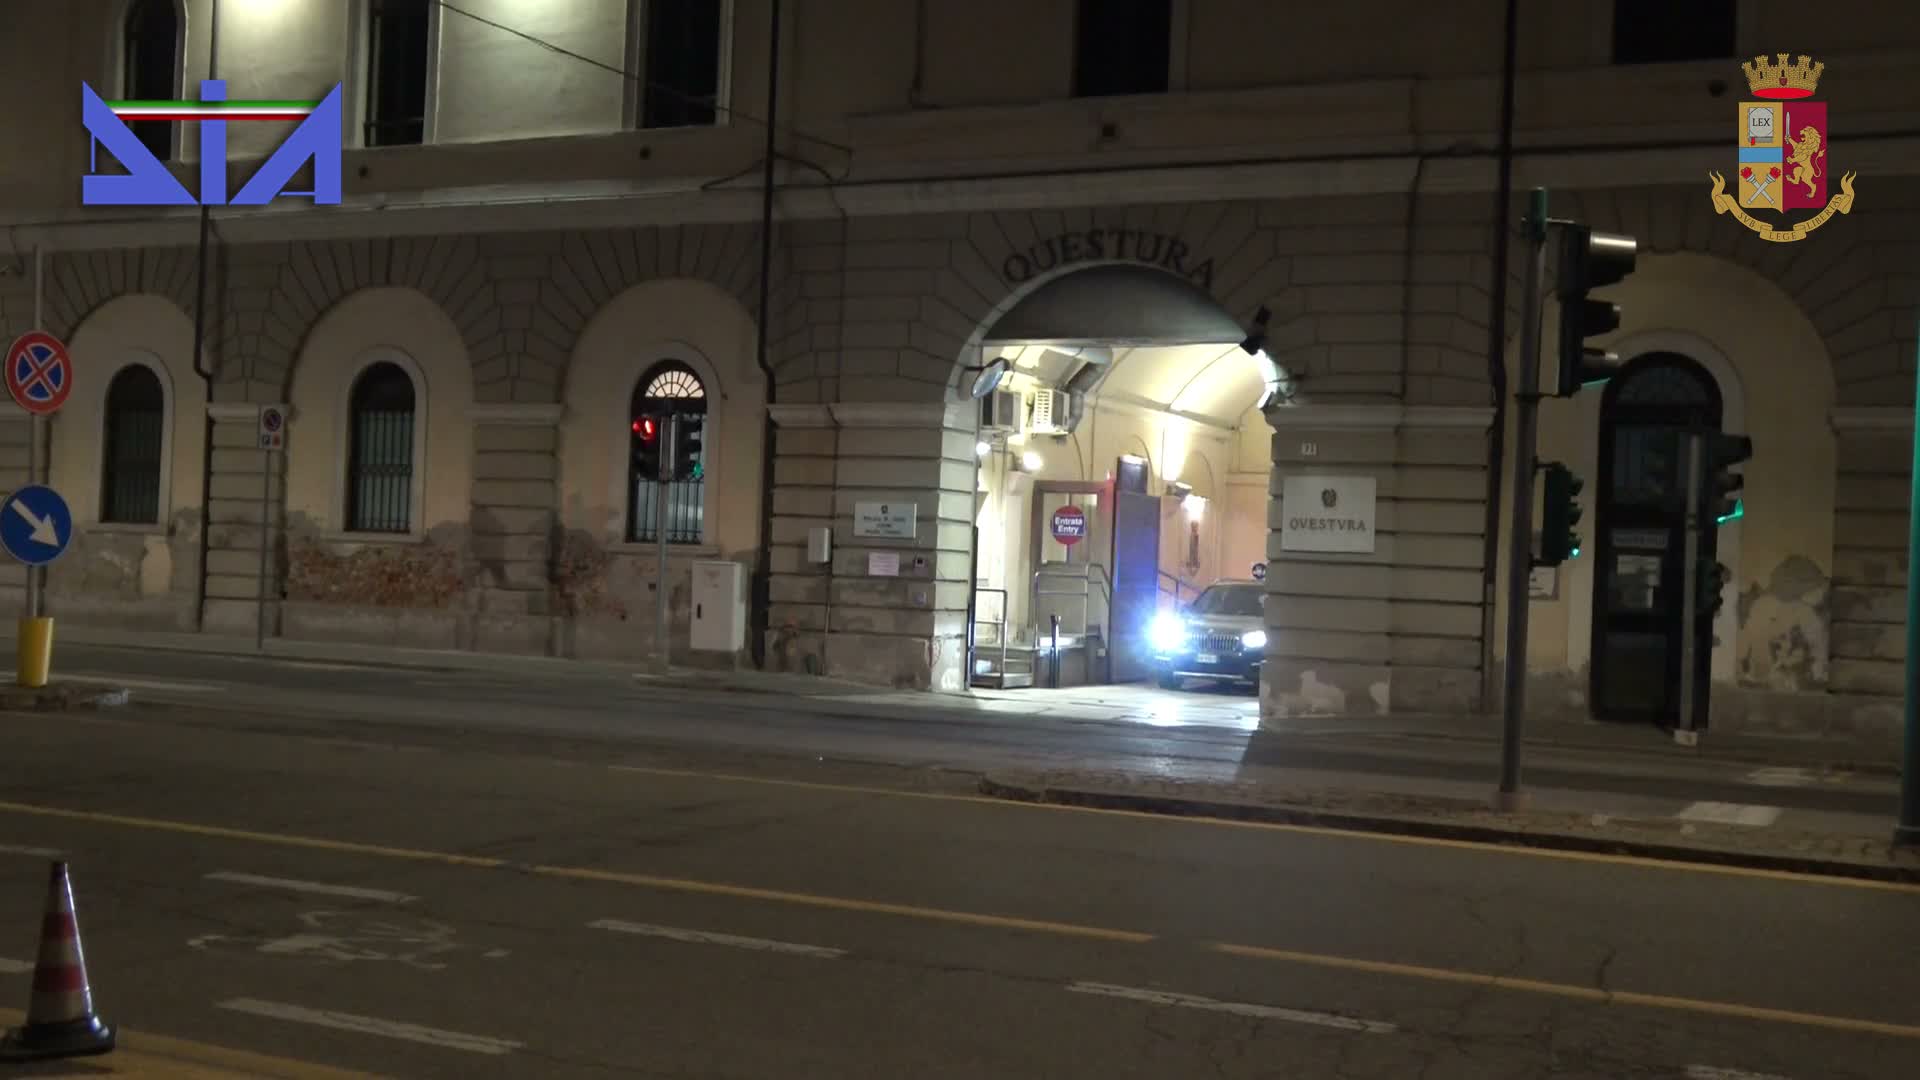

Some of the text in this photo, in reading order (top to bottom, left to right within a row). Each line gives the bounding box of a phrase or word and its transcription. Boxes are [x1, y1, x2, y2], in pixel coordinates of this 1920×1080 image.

[1003, 229, 1215, 289] QUESTURA
[1055, 516, 1083, 526] Entrata
[1289, 517, 1367, 532] QVESTVRA
[1058, 525, 1079, 536] Entry
